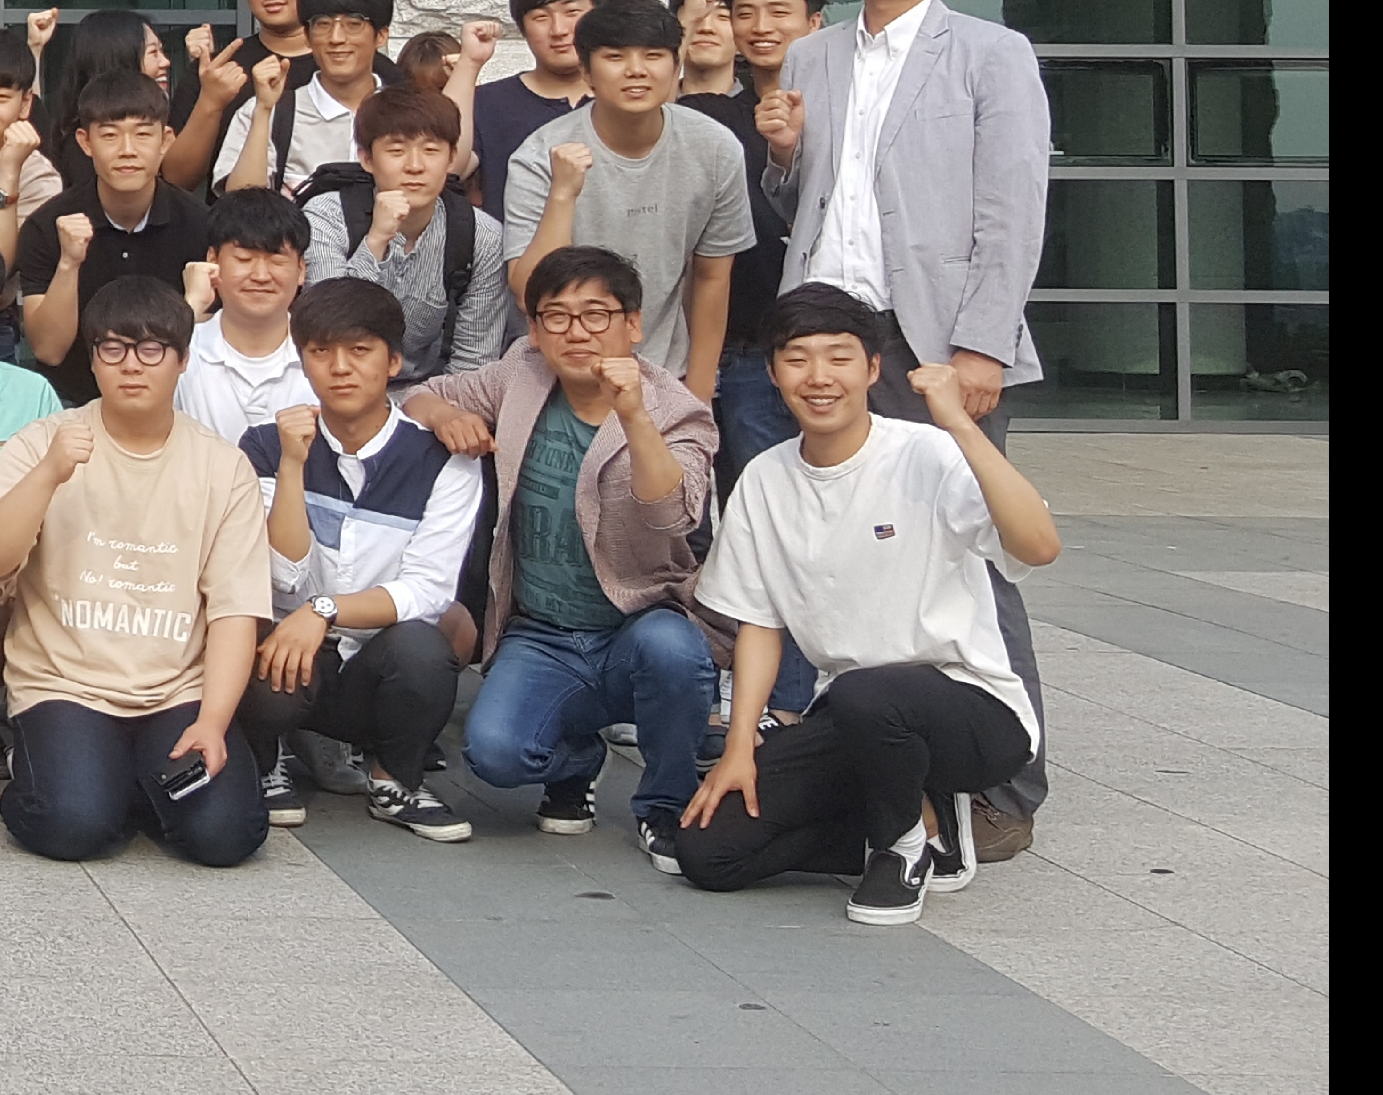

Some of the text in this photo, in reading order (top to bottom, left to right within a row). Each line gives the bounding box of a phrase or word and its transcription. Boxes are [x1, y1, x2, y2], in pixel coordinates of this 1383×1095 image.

[109, 539, 178, 554] romantic
[113, 554, 140, 571] but
[108, 578, 176, 592] romantic
